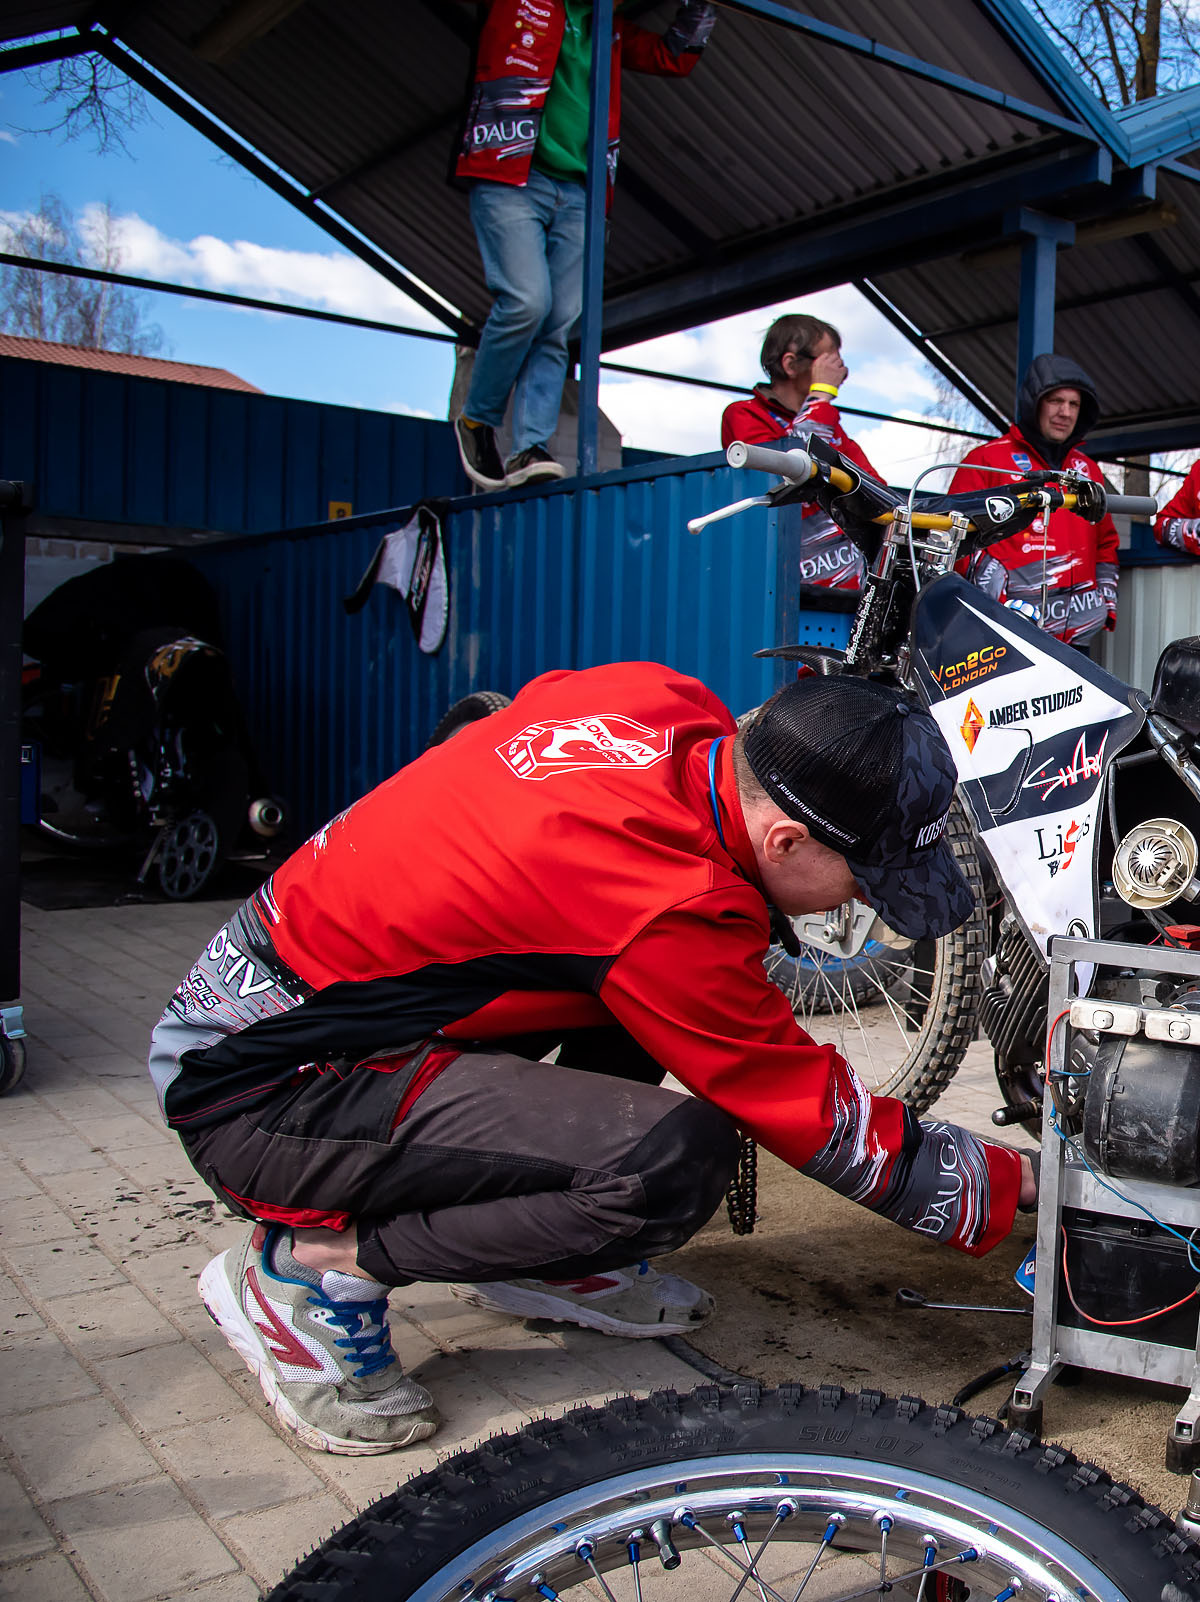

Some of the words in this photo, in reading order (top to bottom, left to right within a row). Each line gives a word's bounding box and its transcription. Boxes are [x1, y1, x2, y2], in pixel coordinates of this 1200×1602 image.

[931, 645, 1007, 682] Van2Go
[943, 661, 998, 692] LONDON
[989, 700, 1030, 727] AMBER
[1031, 685, 1083, 717] STUDIOS
